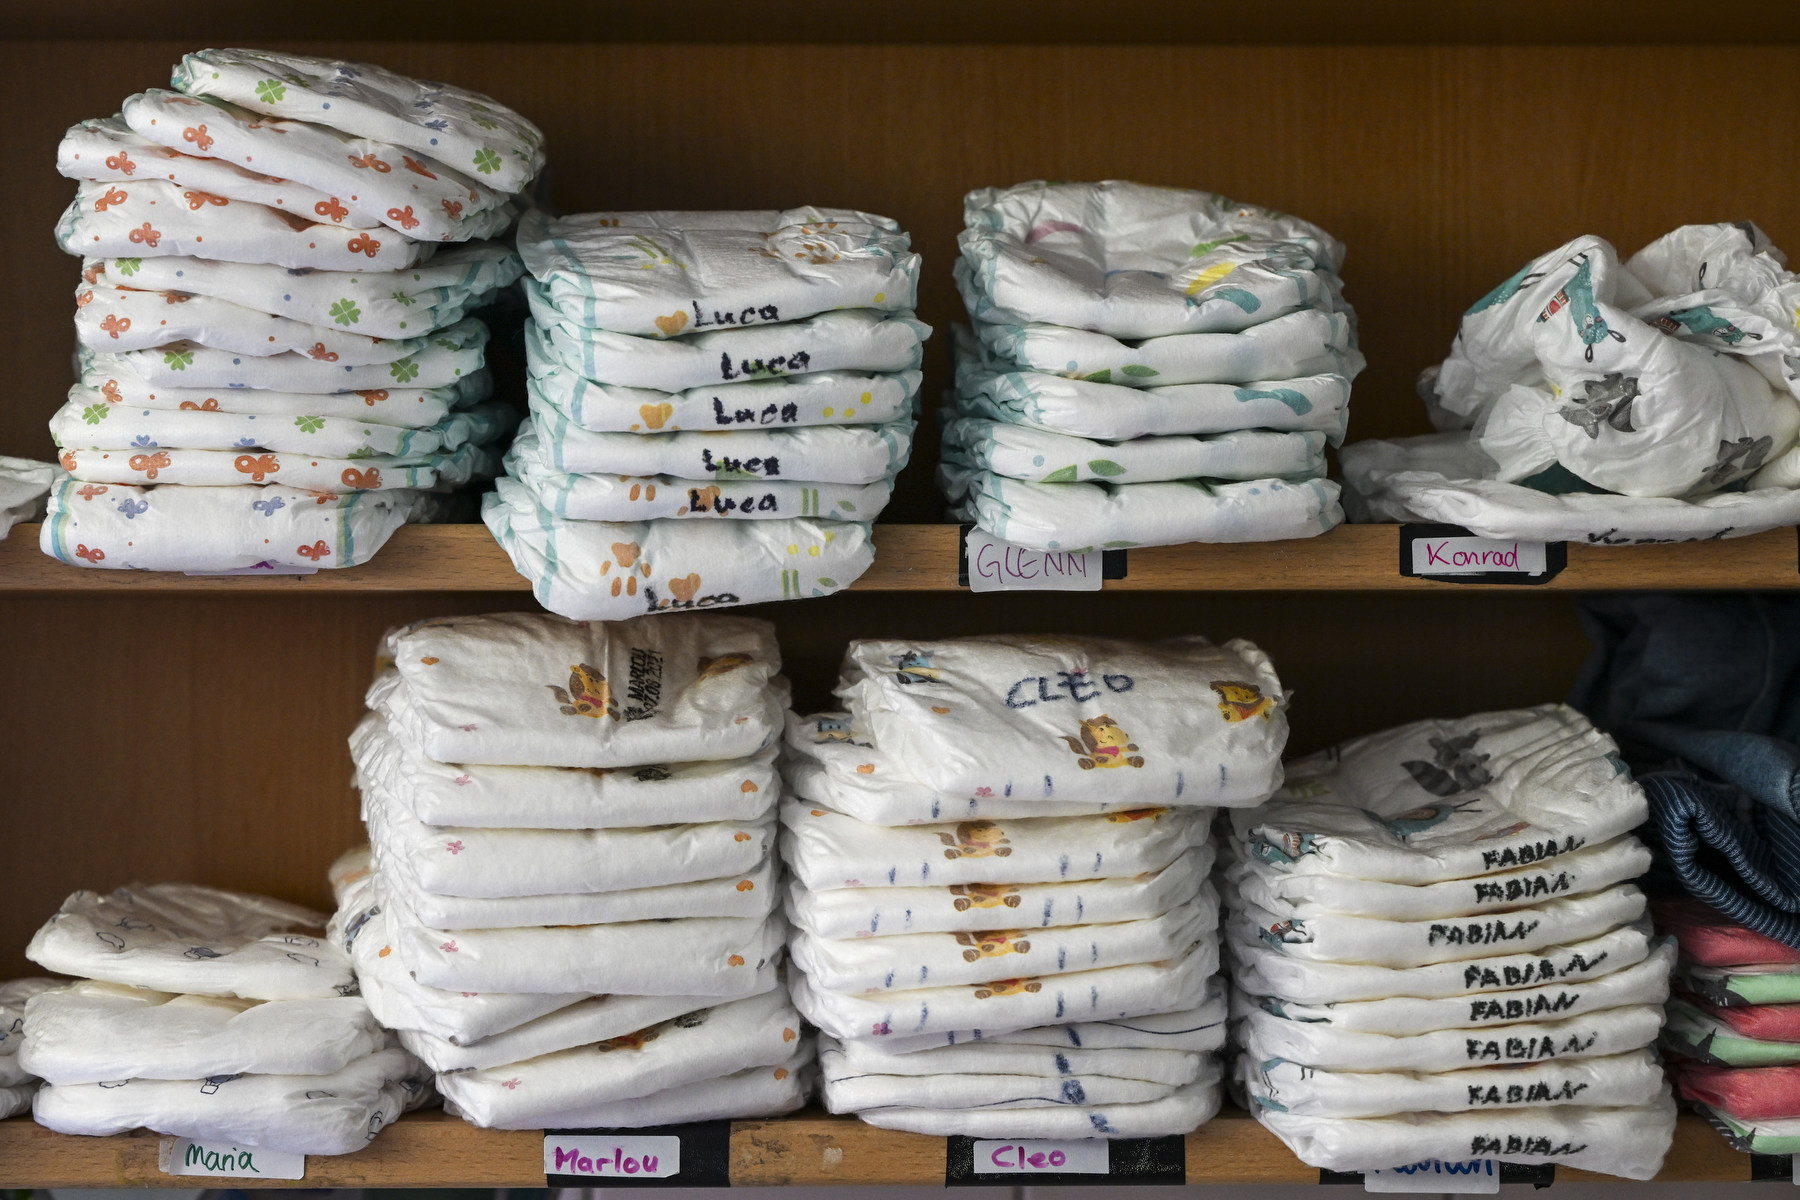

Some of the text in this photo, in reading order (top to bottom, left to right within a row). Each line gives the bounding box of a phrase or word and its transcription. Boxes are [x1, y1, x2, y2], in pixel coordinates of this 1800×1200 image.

[692, 299, 780, 328] Luca
[720, 350, 811, 380] Luca
[713, 396, 798, 425] Luca
[701, 448, 780, 476] Luca
[690, 489, 778, 513] Luca
[976, 543, 1087, 584] GLENN
[1426, 541, 1520, 571] Konrad
[1005, 671, 1135, 709] CLEO
[1482, 835, 1586, 870] FABIAN
[1474, 871, 1576, 904] FABIAN
[1428, 919, 1541, 947] FABIAN
[1464, 950, 1608, 989] FABIAN
[1470, 991, 1580, 1021] FABIAN
[1466, 1031, 1598, 1060] FABIAN
[1468, 1079, 1588, 1105] FABIAN
[185, 1143, 260, 1173] Maria
[554, 1145, 659, 1175] Marlou
[991, 1145, 1066, 1170] Cleo
